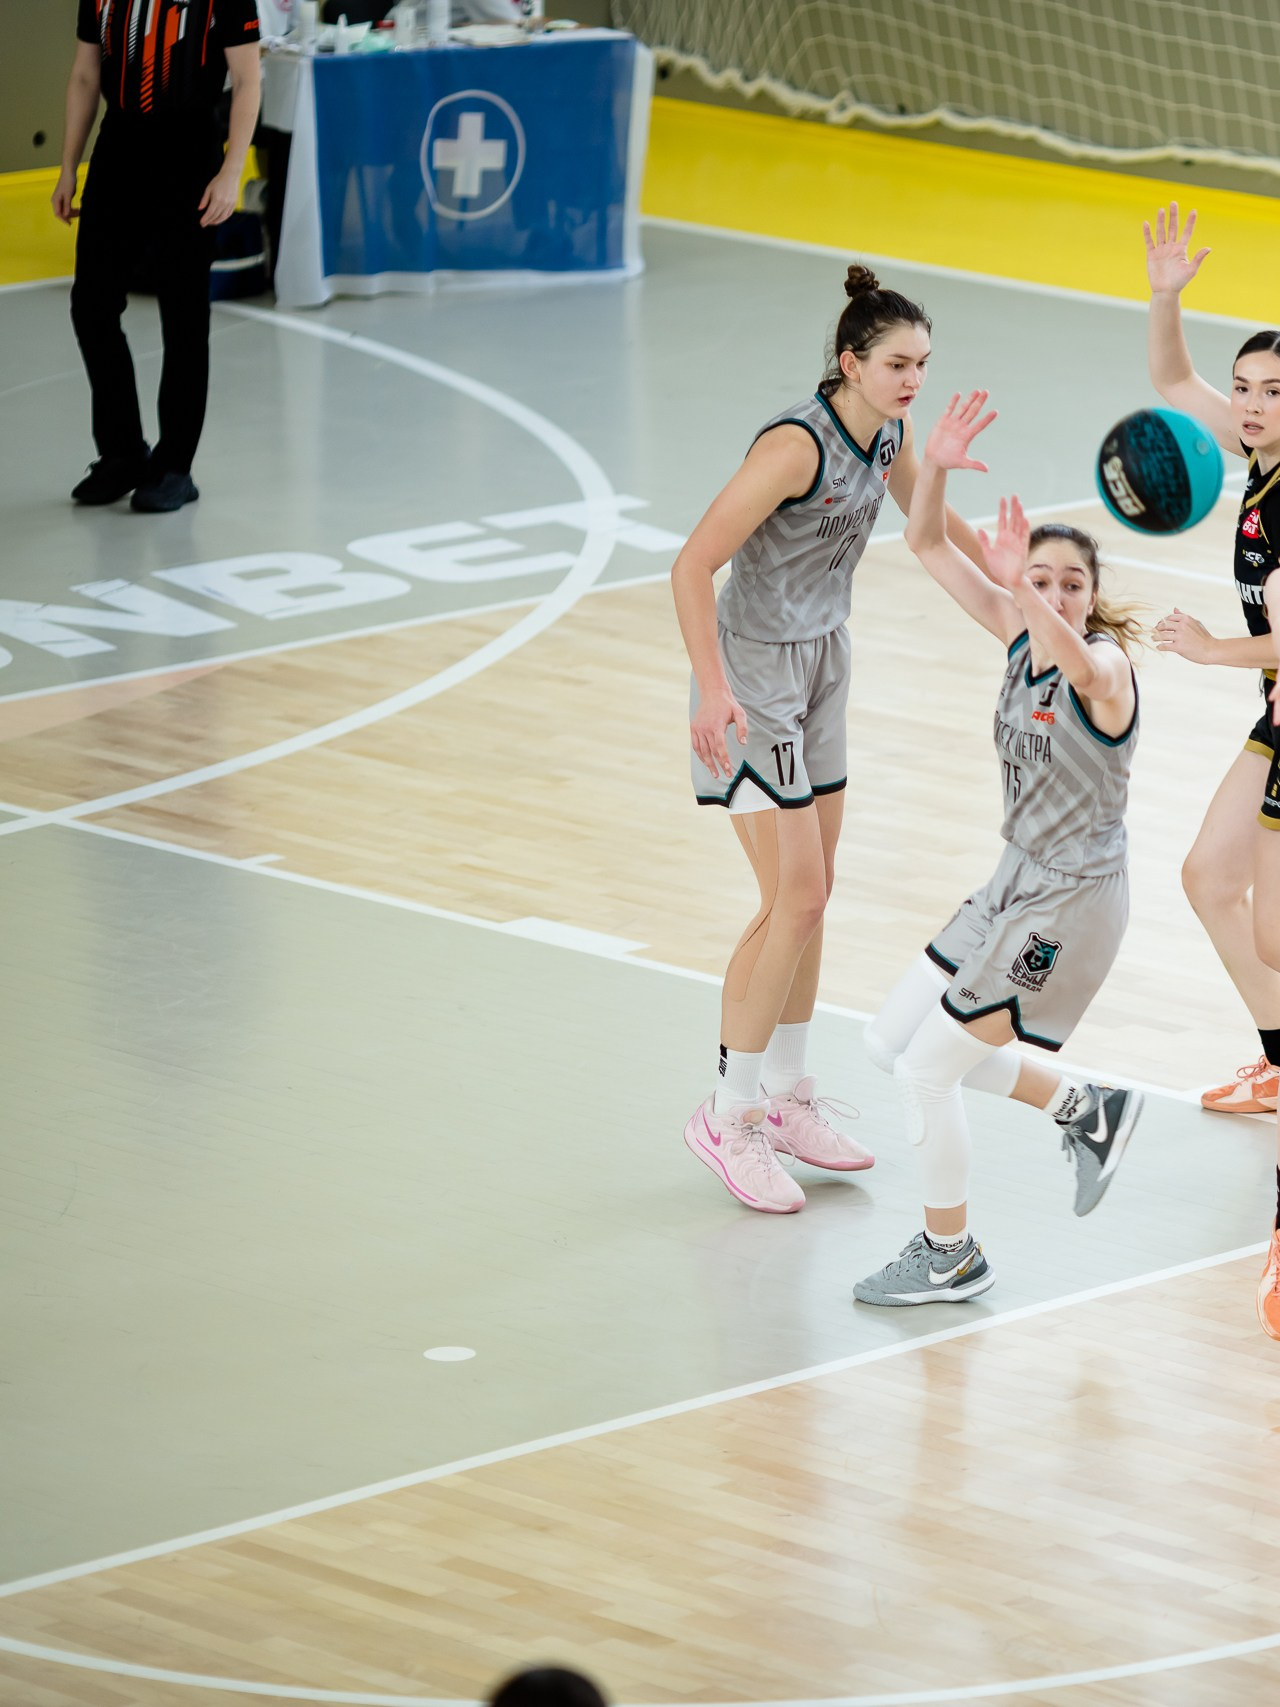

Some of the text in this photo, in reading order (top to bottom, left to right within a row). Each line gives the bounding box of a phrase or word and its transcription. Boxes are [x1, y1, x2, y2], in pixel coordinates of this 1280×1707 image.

[828, 533, 858, 572] 17
[771, 741, 795, 787] 17
[1014, 730, 1052, 764] ПЕТРА
[1003, 759, 1022, 804] 75
[958, 987, 981, 1004] STK
